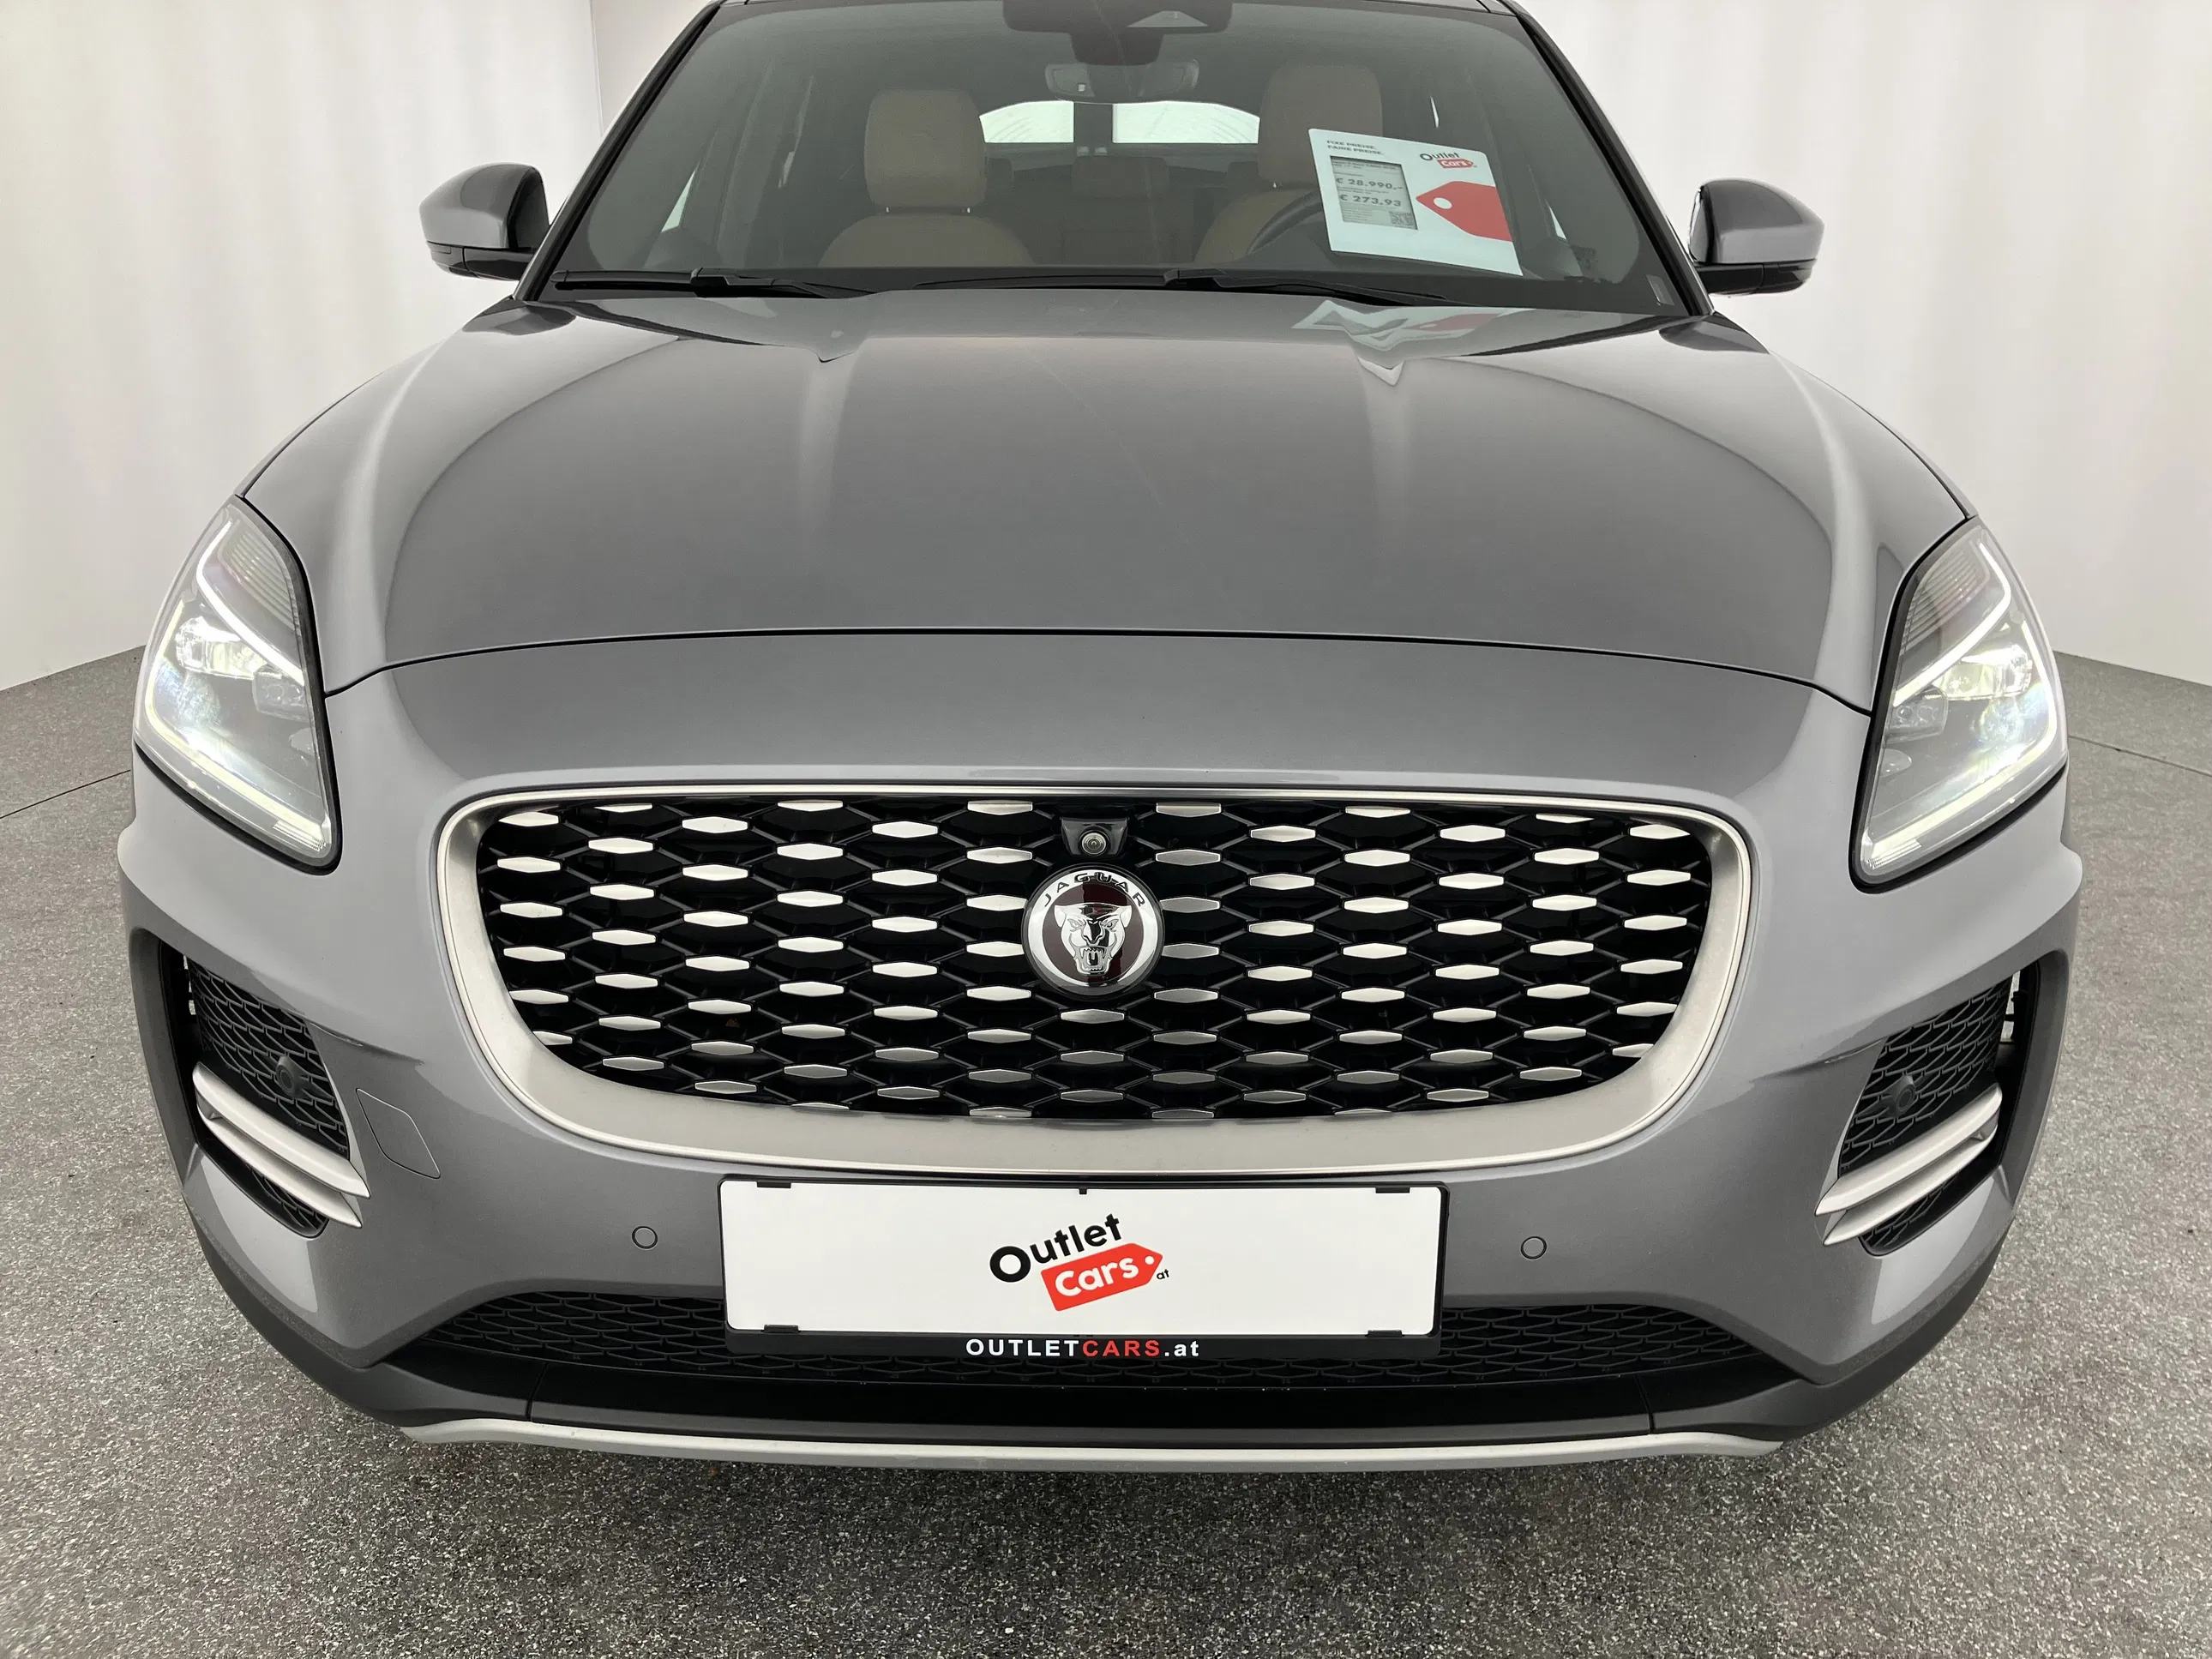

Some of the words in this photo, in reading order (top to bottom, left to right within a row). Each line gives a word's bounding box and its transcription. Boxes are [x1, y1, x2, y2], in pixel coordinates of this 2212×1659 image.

[1420, 152, 1460, 161] Outlet
[1353, 195, 1402, 207] 273.93
[1044, 872, 1145, 907] JAGUAR
[989, 1213, 1122, 1283] Outlet
[1055, 1257, 1139, 1296] Cars
[1156, 1269, 1170, 1280] at
[965, 1338, 1199, 1357] OUTLETCARS.at
